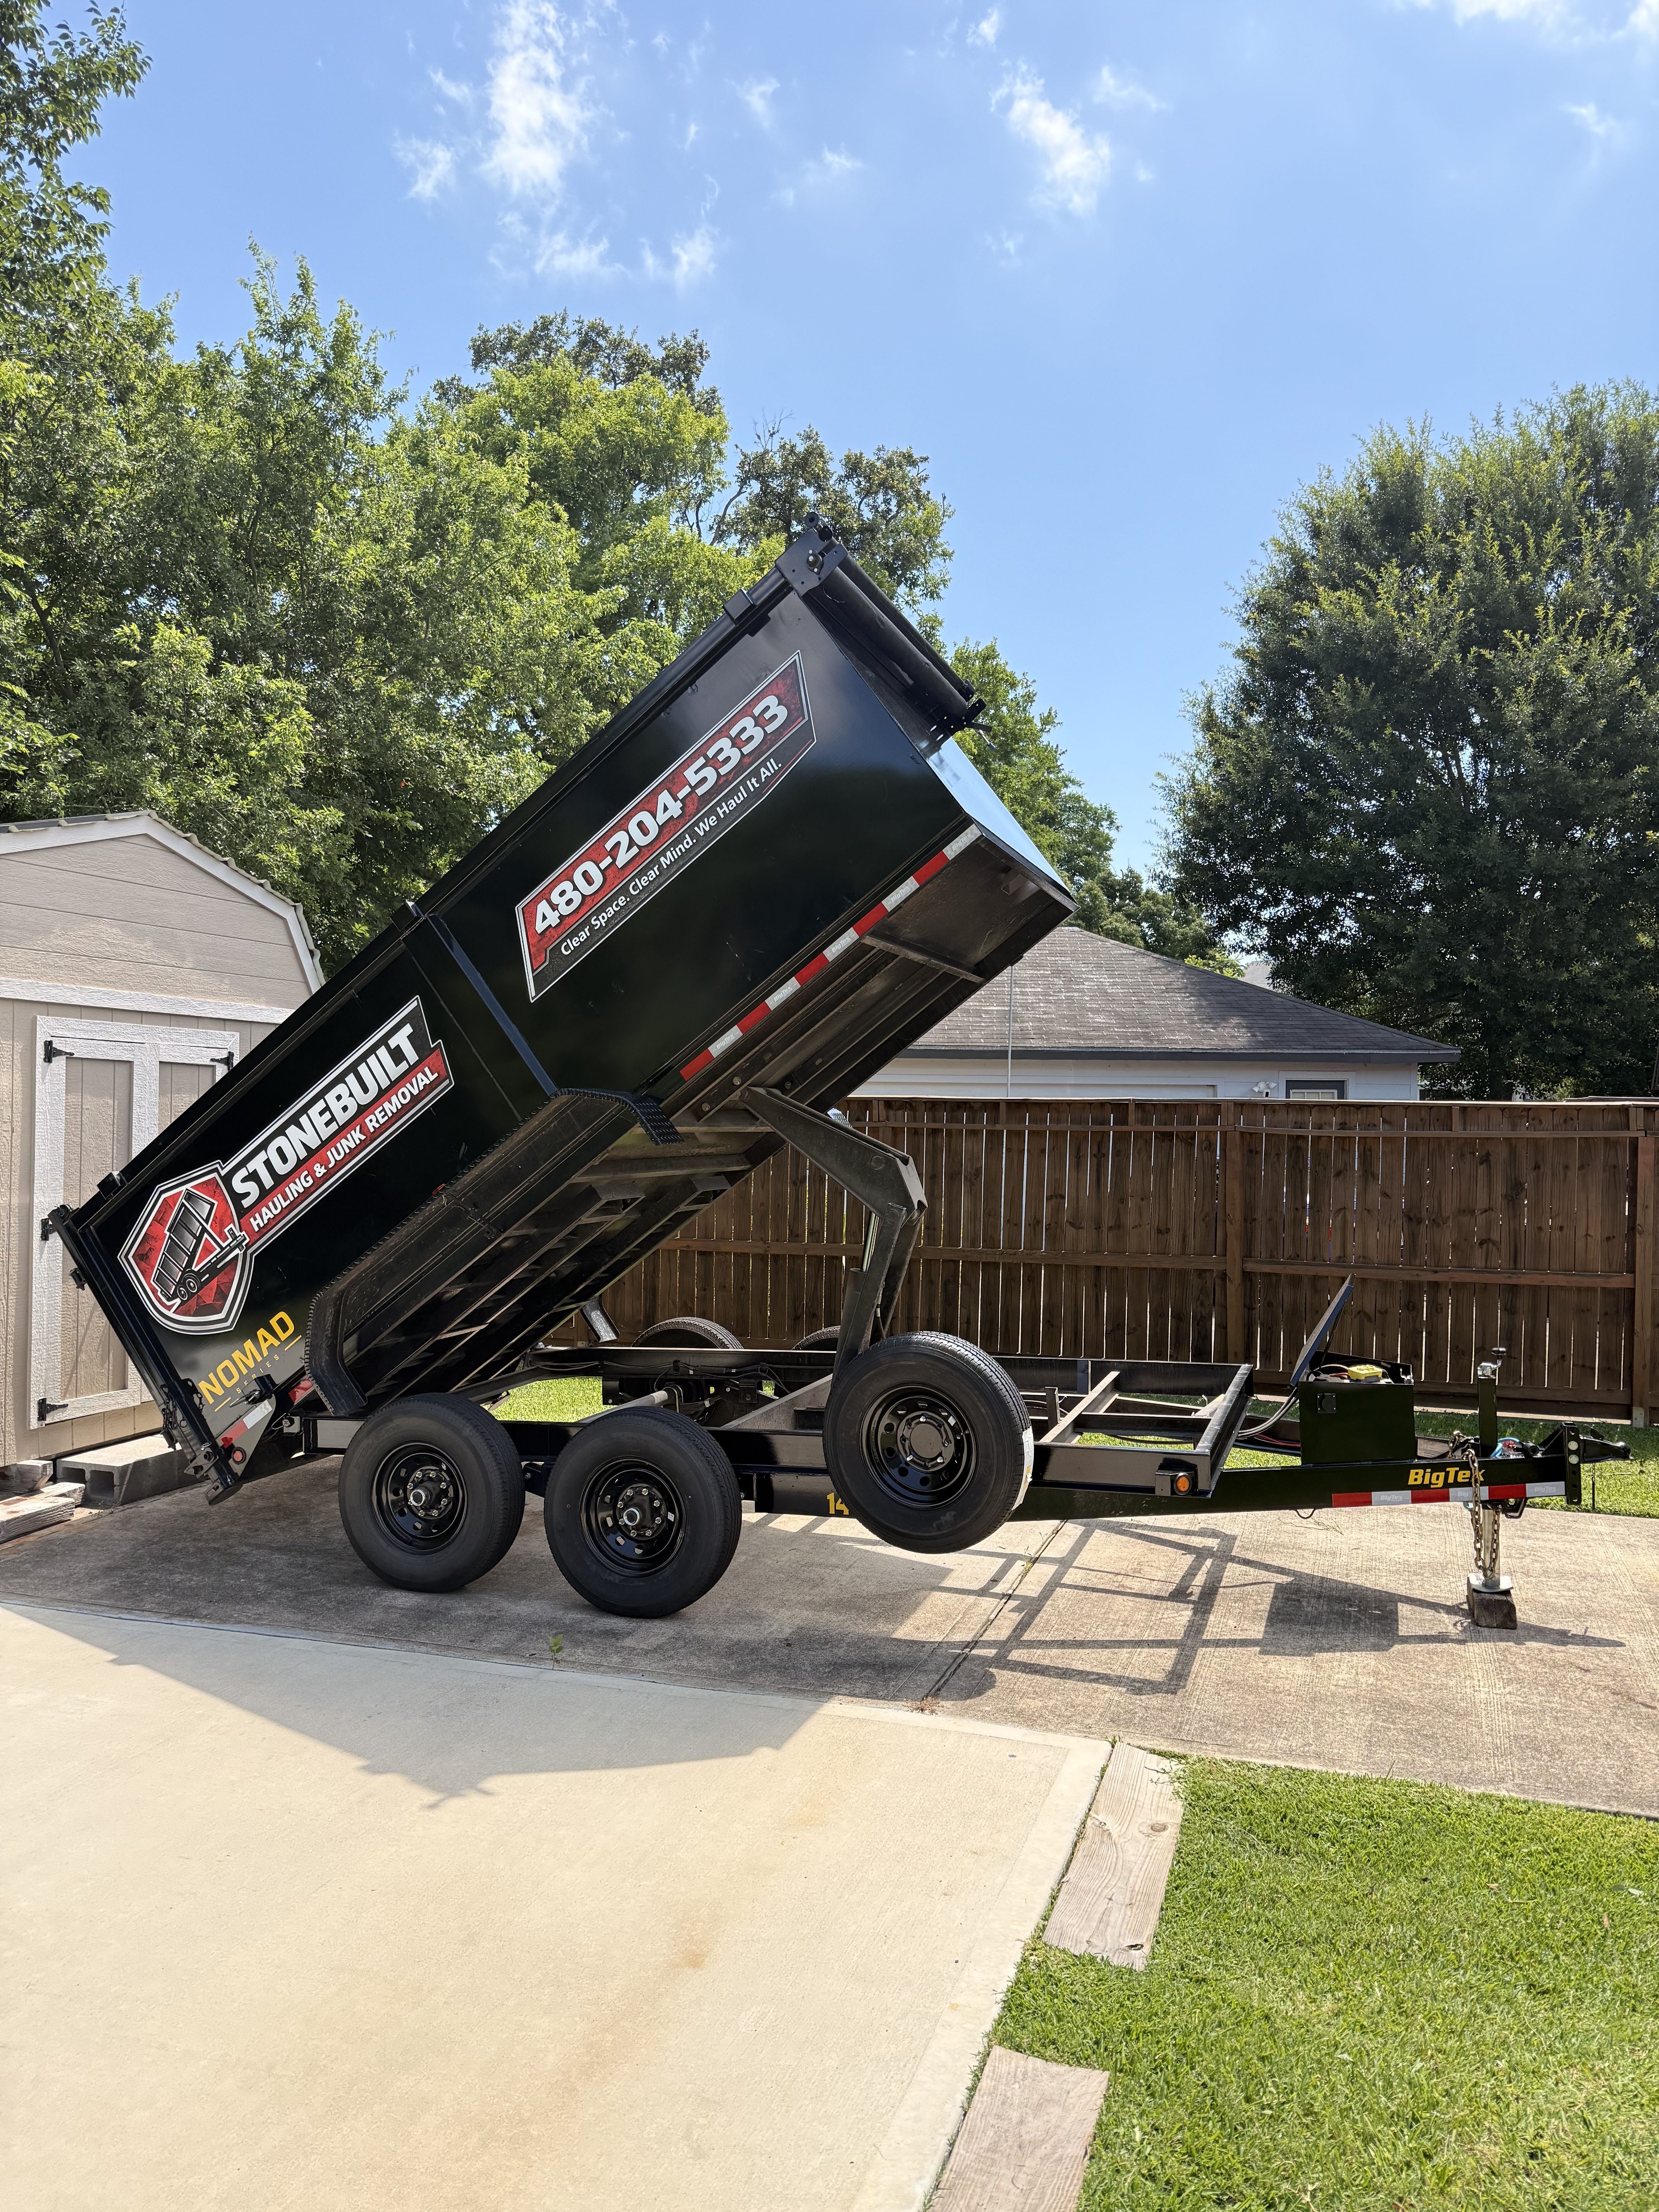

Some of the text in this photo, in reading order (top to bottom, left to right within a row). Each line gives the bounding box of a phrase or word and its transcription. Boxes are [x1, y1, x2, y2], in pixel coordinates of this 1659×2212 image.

[536, 695, 788, 934] 480-204-5333
[561, 761, 781, 955] Clear Space. Clear Mind. We Haul It All.
[891, 885, 910, 903] BigTex
[831, 937, 851, 953] BigTex
[774, 986, 792, 1002] BigTex
[716, 1033, 734, 1049] BigTex
[232, 1023, 419, 1208] STONEBUILT
[249, 1068, 439, 1233] HAULING & JUNK REMOVAL
[198, 1311, 294, 1405] NOMAD
[236, 1354, 279, 1394] SERIES
